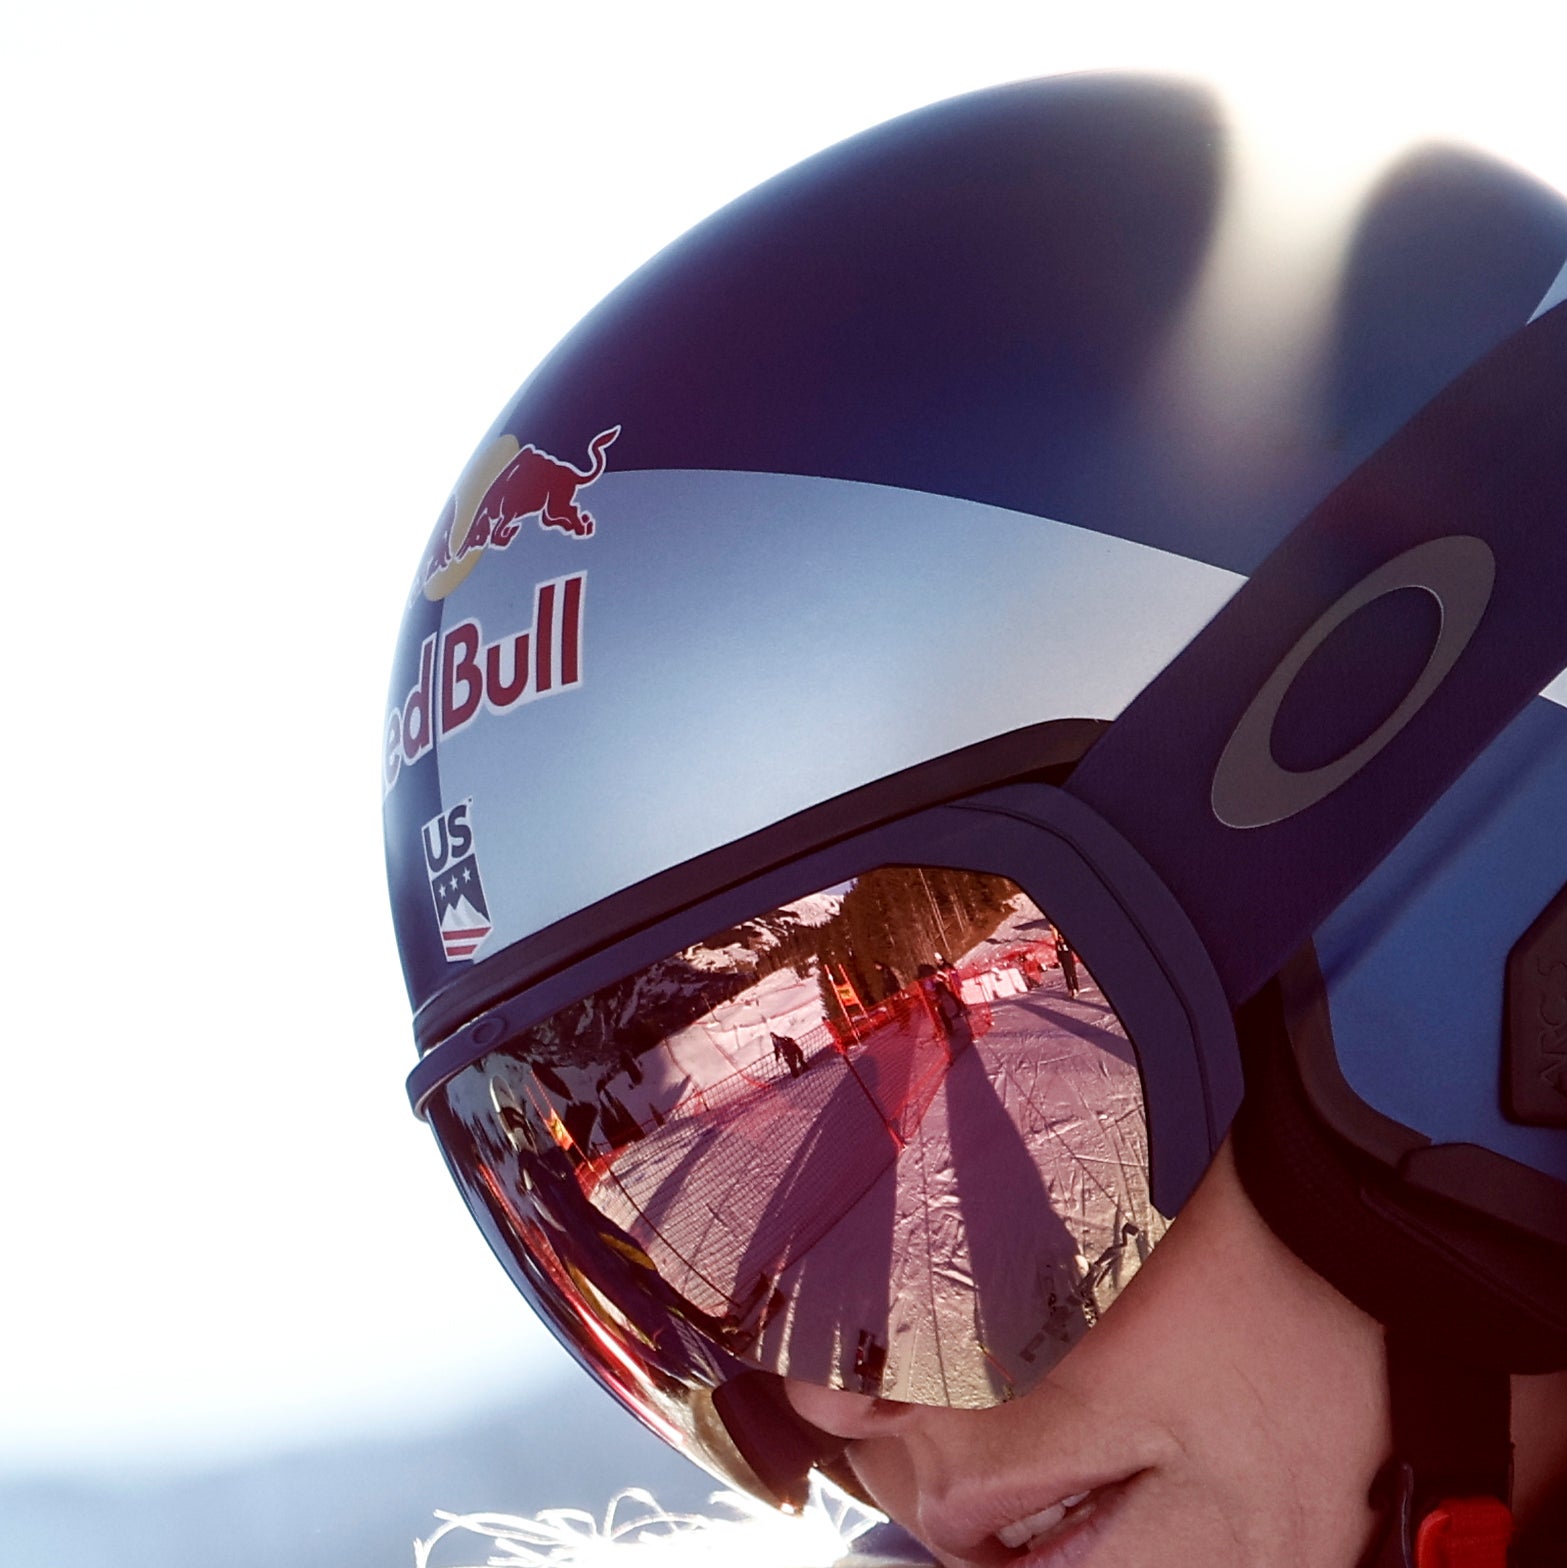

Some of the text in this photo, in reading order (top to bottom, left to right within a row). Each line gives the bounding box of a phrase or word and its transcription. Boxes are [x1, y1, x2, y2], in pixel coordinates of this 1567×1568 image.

[384, 571, 585, 794] ed Bull
[422, 804, 473, 874] US
